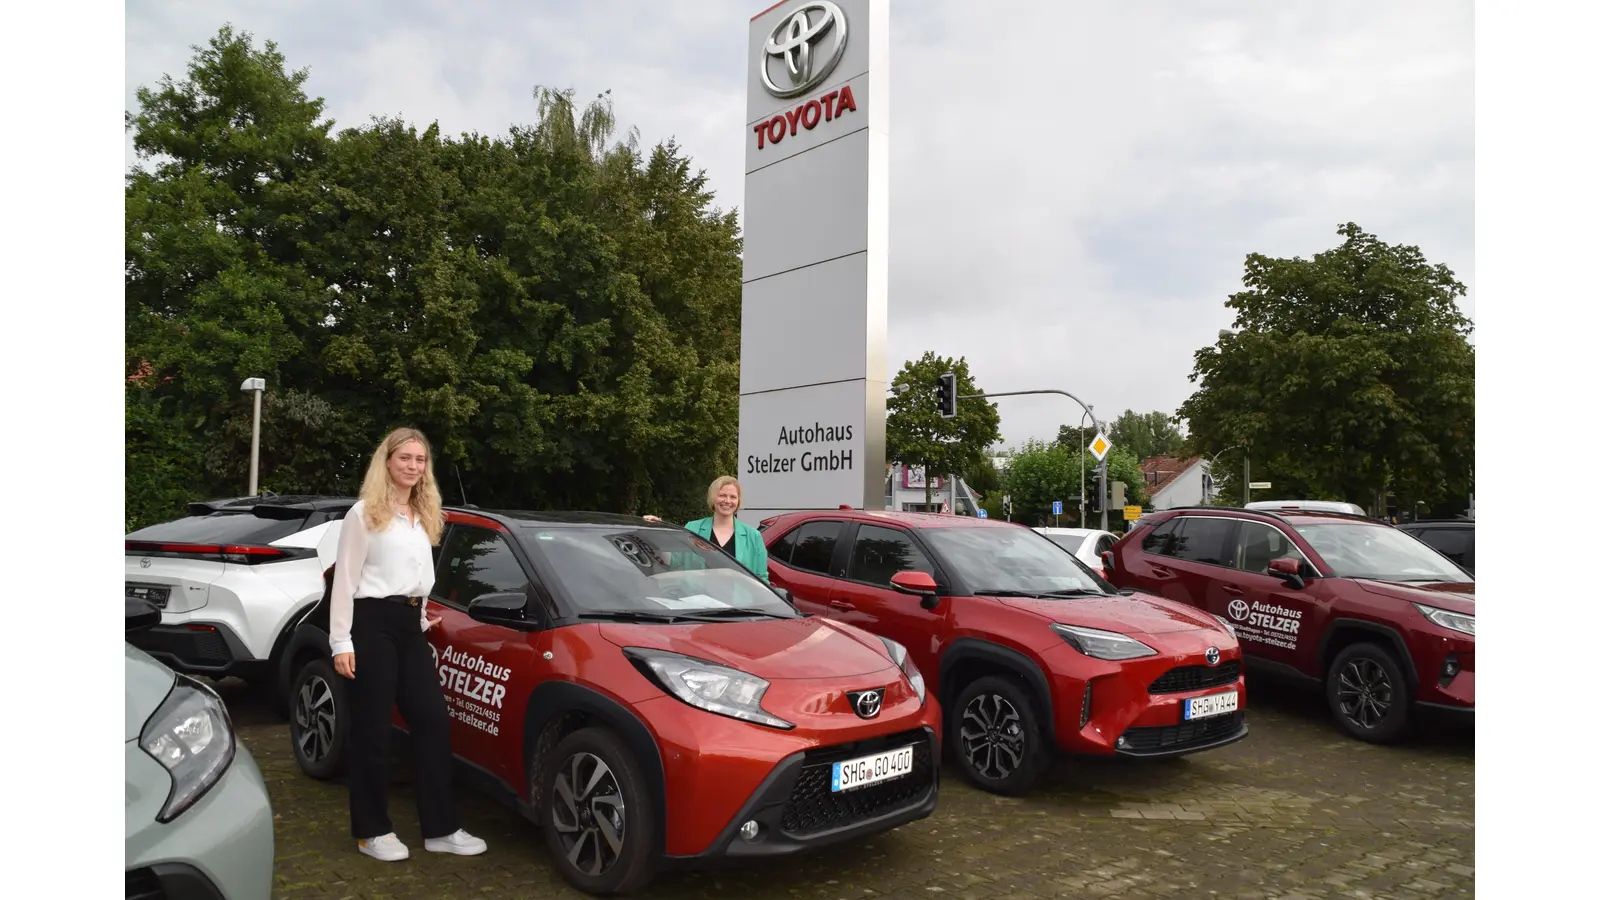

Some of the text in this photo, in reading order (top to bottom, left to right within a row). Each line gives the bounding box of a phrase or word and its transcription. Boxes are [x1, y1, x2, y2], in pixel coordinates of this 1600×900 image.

[753, 85, 857, 150] TOYOTA
[777, 422, 853, 446] Autohaus
[747, 449, 853, 474] Stelzer GmbH
[1251, 600, 1303, 619] Autohaus
[1248, 612, 1300, 634] STELZER
[441, 645, 512, 682] Autohaus
[438, 664, 506, 709] STELZER
[455, 697, 465, 708] Tel.
[465, 701, 501, 722] 05721/4515
[1192, 698, 1209, 716] SHG
[842, 761, 866, 785] SHG
[875, 756, 889, 777] GO
[891, 750, 910, 773] 400
